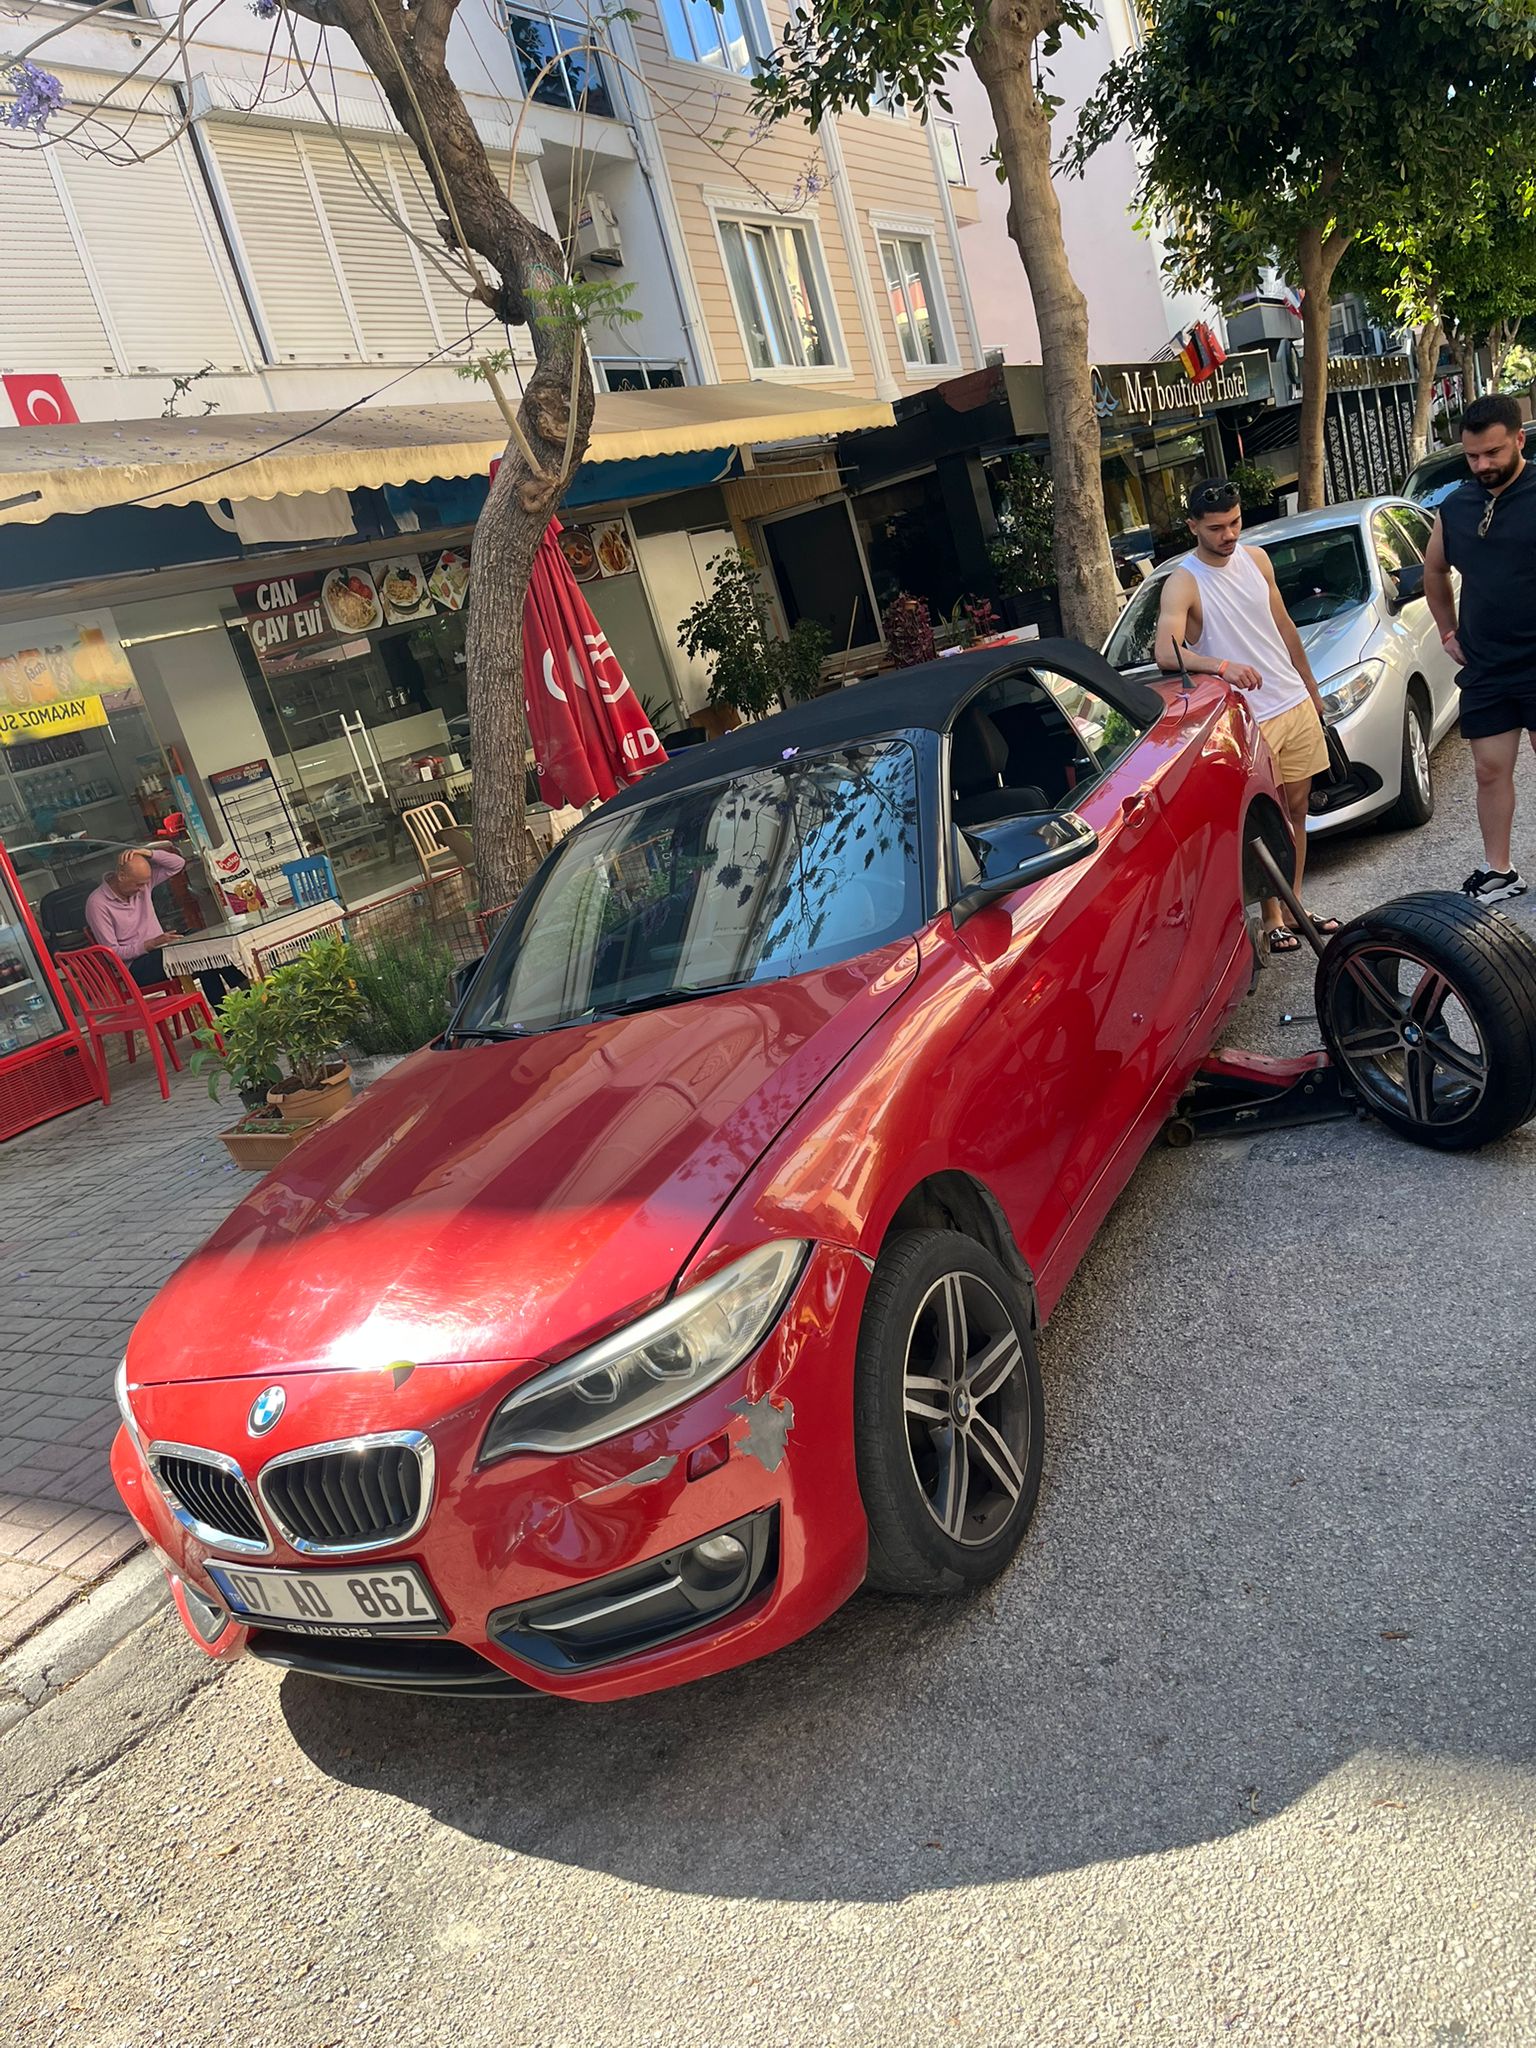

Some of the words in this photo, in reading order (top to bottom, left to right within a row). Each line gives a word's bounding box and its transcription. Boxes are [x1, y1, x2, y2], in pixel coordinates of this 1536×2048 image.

[1121, 371, 1152, 426] My
[1152, 369, 1214, 417] boutique
[1214, 361, 1249, 401] Hotel
[256, 578, 298, 611] CAN
[252, 615, 289, 652] ÇAY
[293, 600, 324, 639] EVİ
[228, 1591, 244, 1604] TR
[230, 1574, 272, 1611] 07
[283, 1579, 334, 1618] AD
[347, 1575, 430, 1619] 862
[308, 1626, 373, 1638] MOTORS
